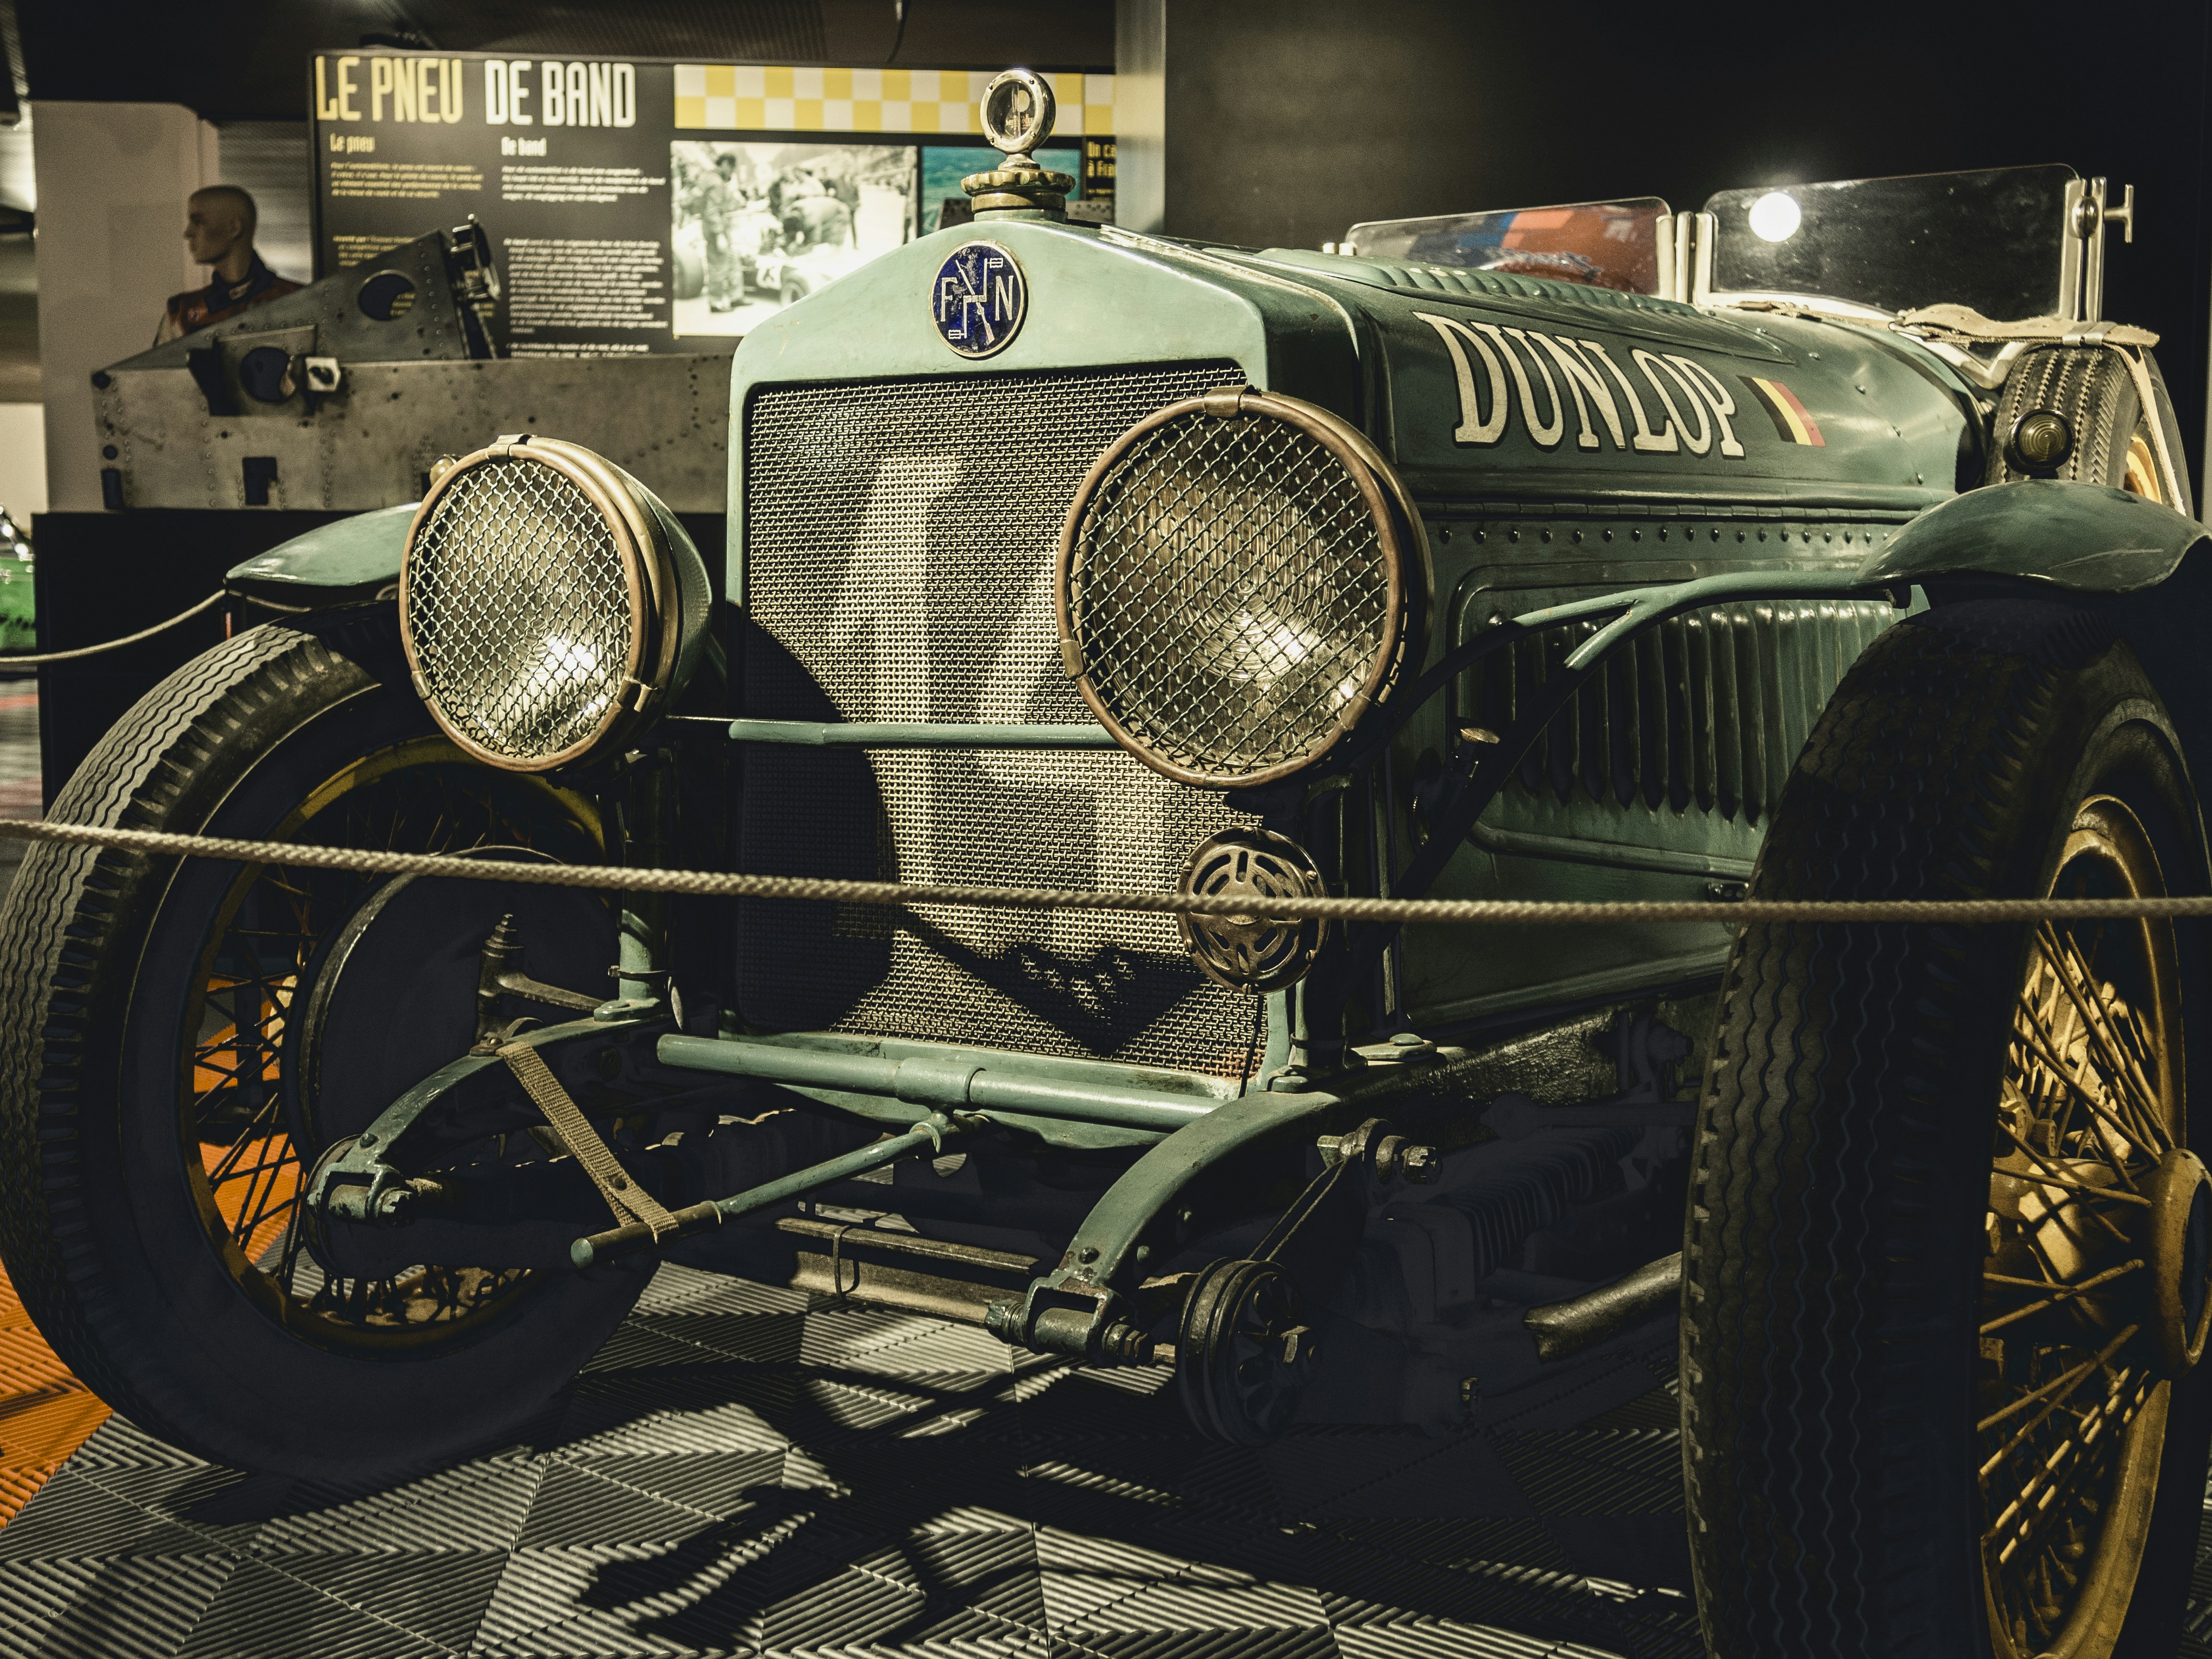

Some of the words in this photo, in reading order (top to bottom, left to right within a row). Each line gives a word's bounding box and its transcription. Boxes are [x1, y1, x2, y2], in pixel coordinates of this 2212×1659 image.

[315, 56, 361, 120] LE
[371, 57, 463, 124] PNEU
[484, 60, 533, 125] DE
[541, 61, 636, 127] BAND
[330, 133, 345, 152] Le
[347, 136, 375, 155] pneu
[501, 136, 517, 156] De
[518, 137, 546, 156] band
[1412, 311, 1745, 458] DUNLOP
